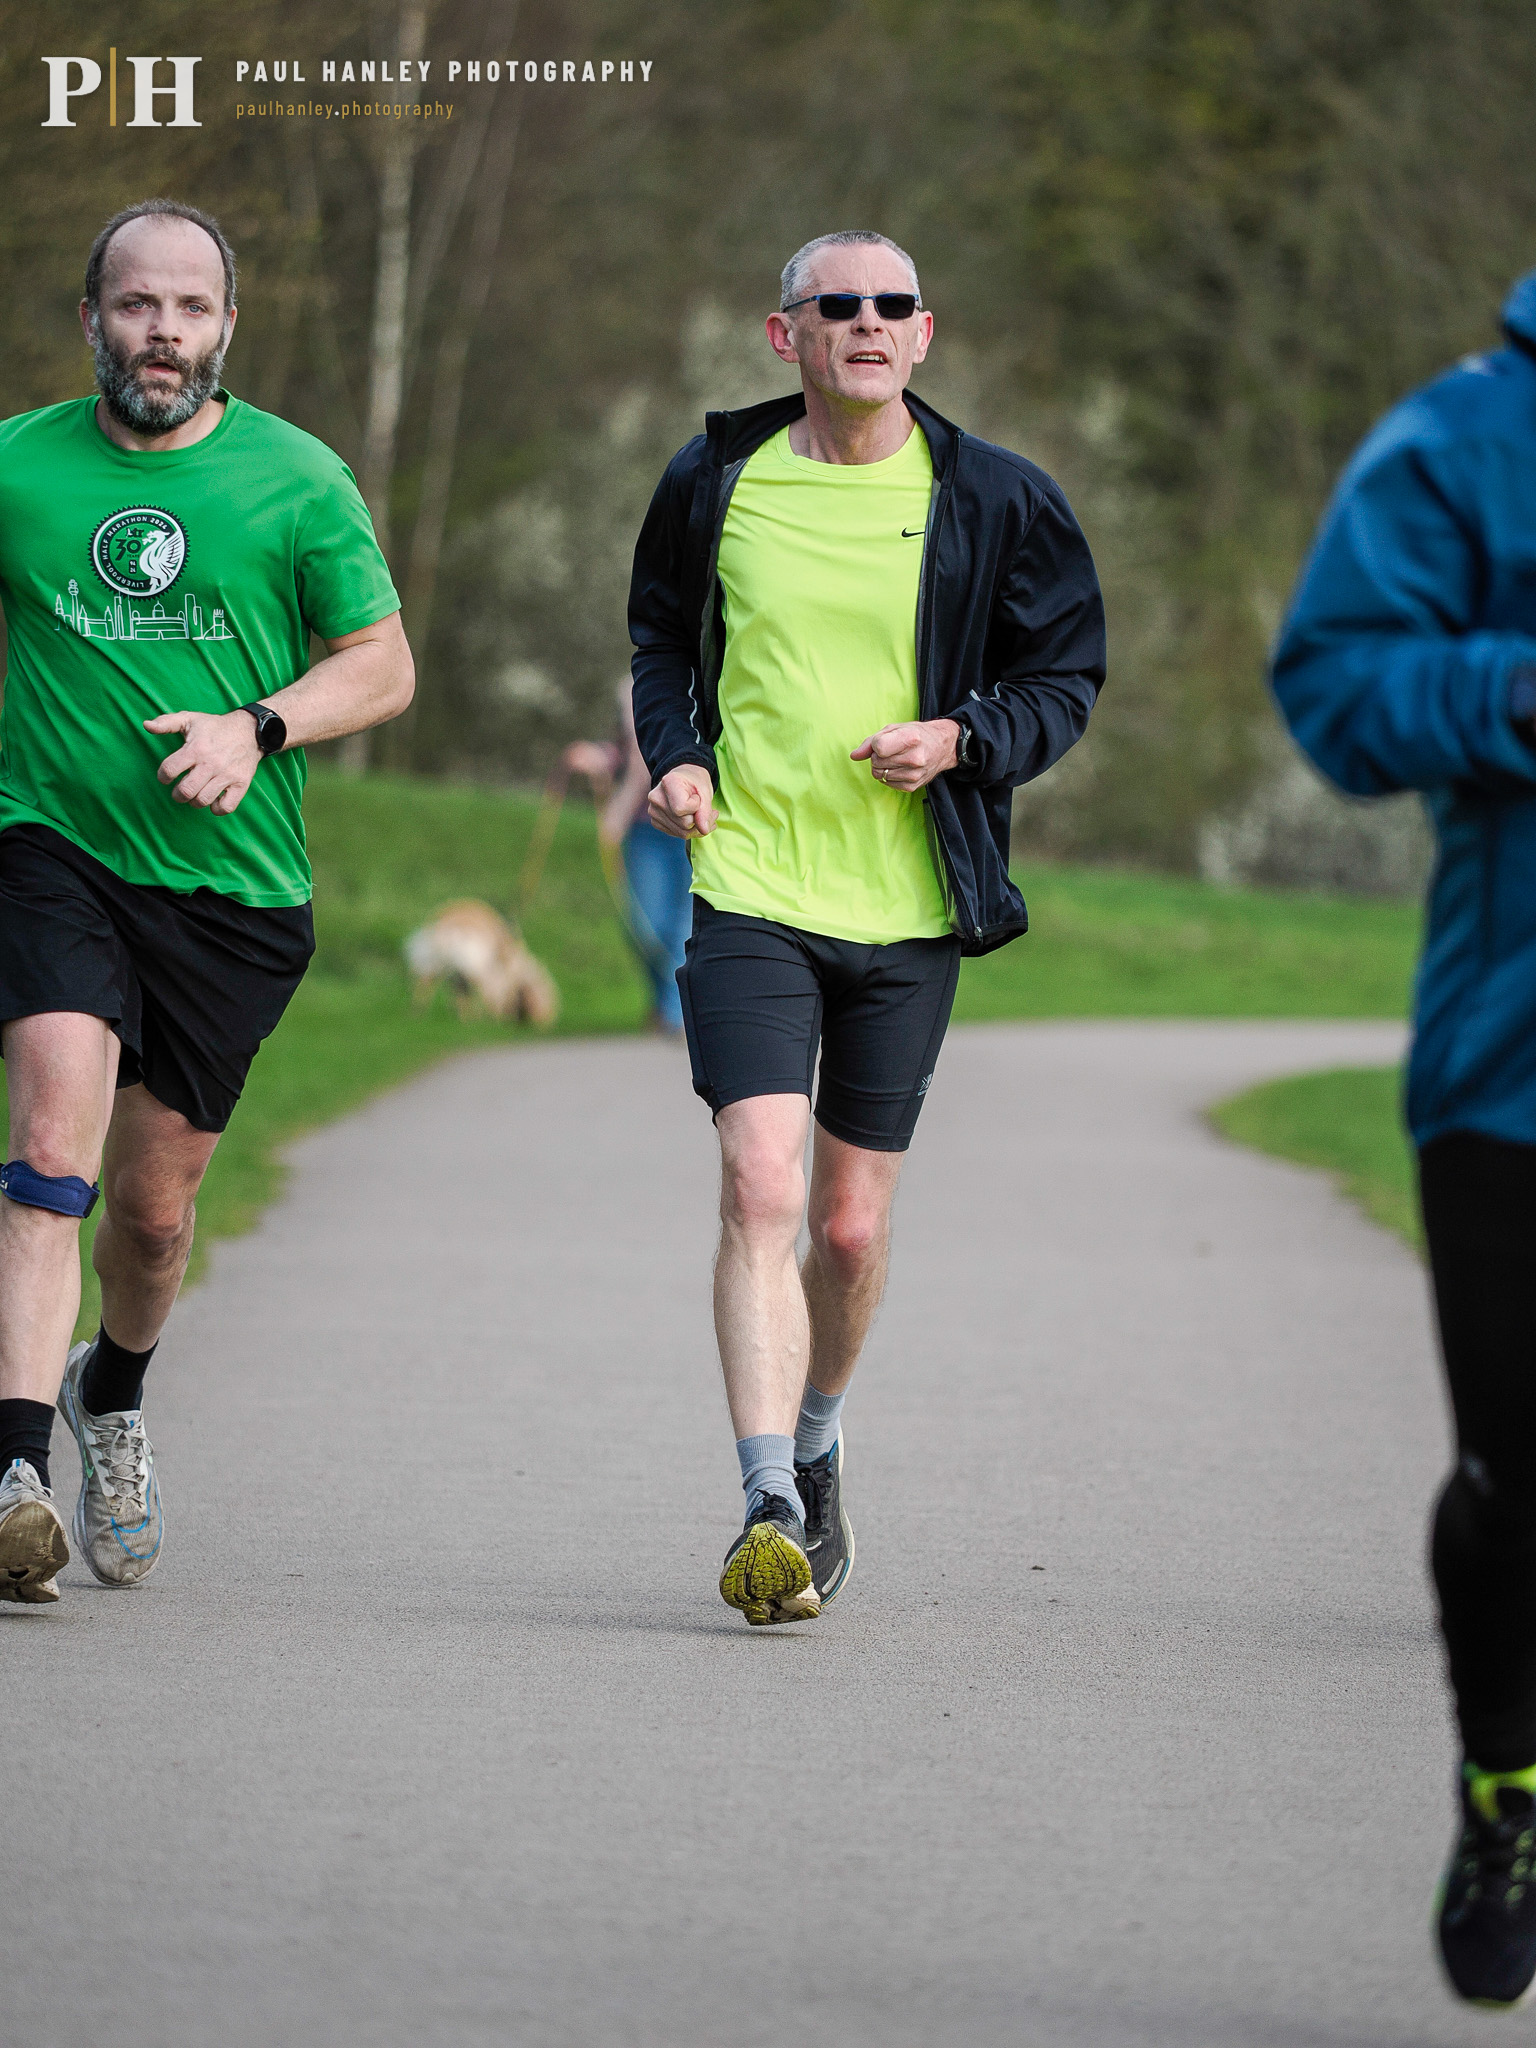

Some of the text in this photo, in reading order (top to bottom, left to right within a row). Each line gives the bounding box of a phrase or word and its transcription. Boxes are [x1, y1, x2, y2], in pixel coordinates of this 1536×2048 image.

[107, 516, 148, 537] MARATHON
[150, 517, 168, 530] 2024
[105, 563, 144, 588] LIVERPOOL
